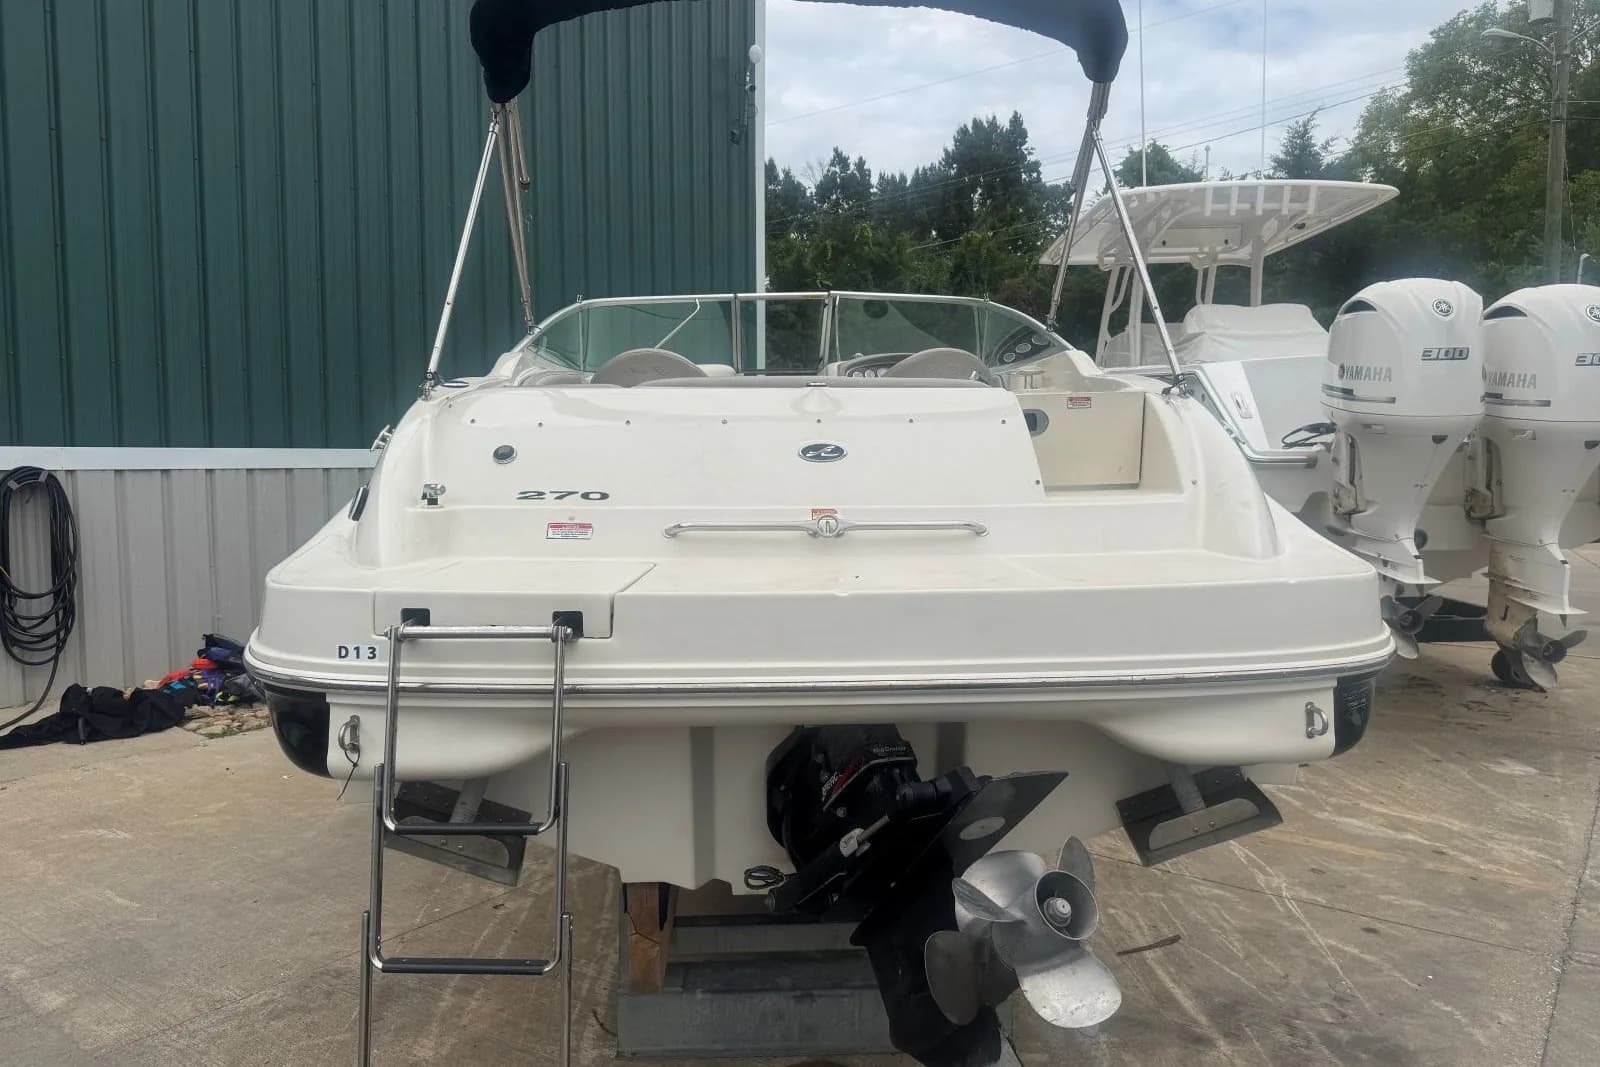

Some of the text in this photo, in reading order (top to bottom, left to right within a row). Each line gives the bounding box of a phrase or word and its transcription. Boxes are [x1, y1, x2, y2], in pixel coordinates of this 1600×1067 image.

[1421, 347, 1470, 361] 300
[1345, 365, 1392, 382] YAMAHA
[1488, 371, 1537, 389] YAMAHA
[516, 490, 610, 501] 270
